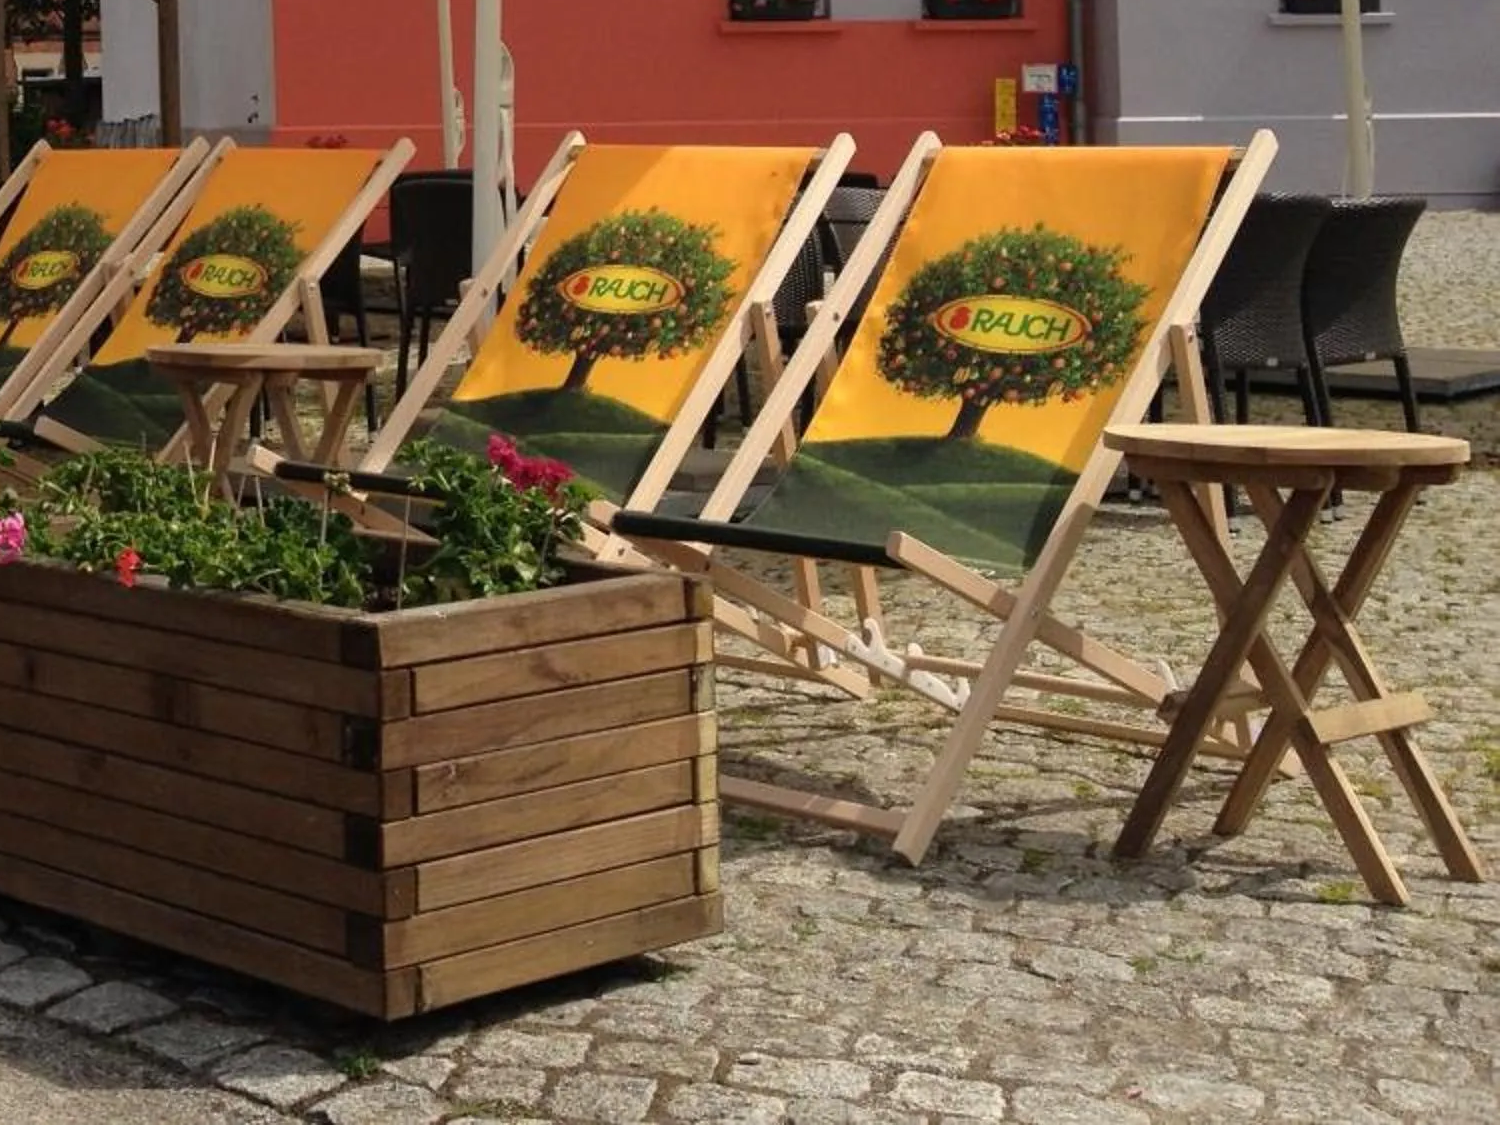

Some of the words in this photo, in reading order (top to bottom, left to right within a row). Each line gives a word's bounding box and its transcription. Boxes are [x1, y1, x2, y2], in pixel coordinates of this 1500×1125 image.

[200, 263, 257, 289] RAUCH
[587, 276, 669, 304] RAUCH
[970, 308, 1072, 342] RAUCH
